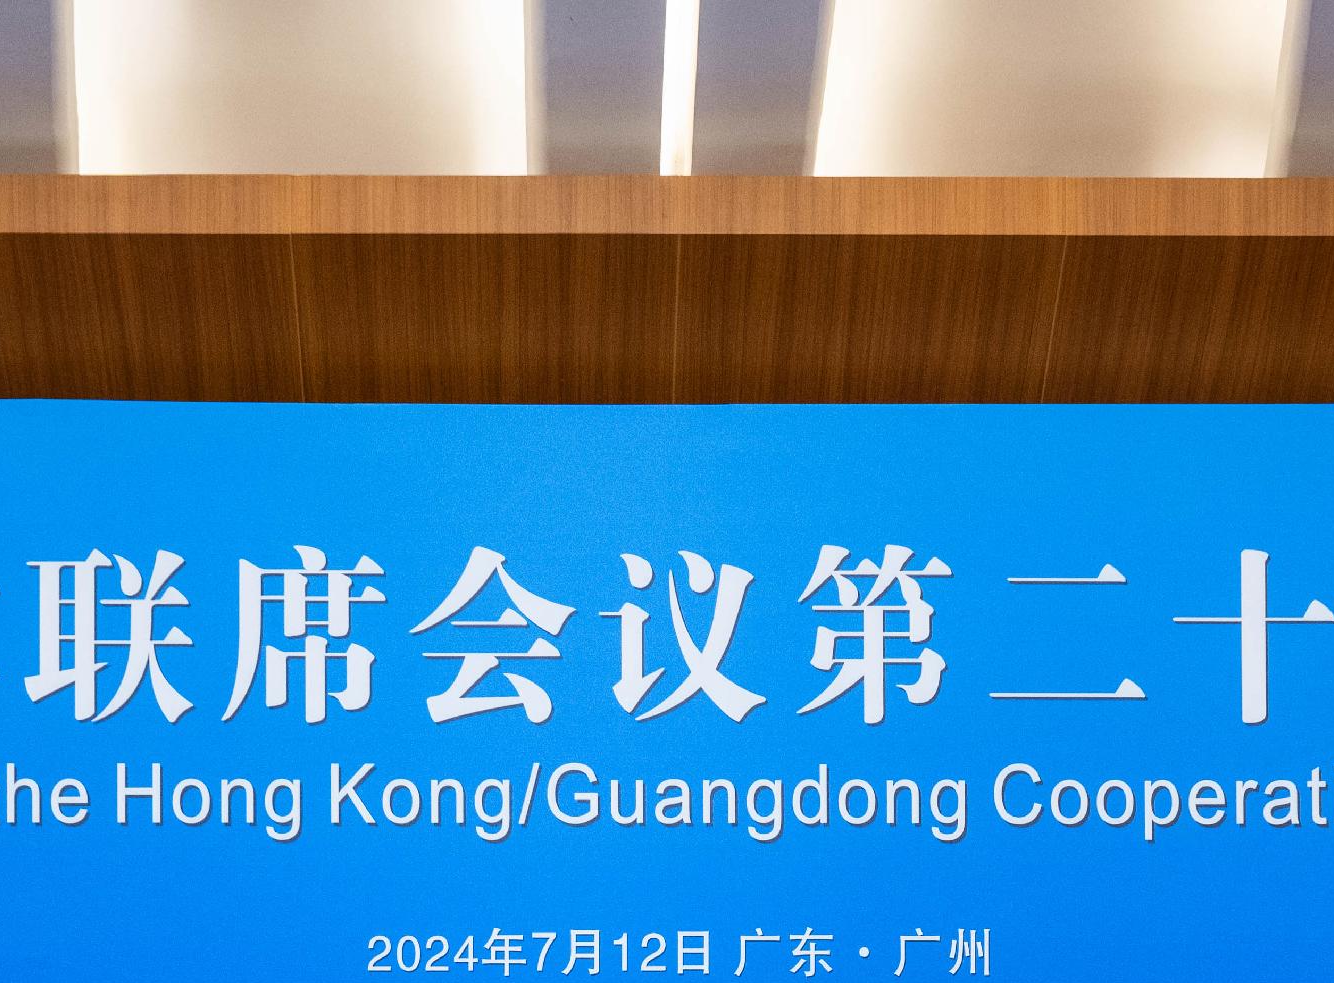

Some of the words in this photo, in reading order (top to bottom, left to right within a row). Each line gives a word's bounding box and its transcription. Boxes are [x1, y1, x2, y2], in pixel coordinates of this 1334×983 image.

[116, 762, 302, 841] Hong
[330, 762, 967, 841] Kong/Guangdong
[367, 927, 710, 977] 2024年7月12日
